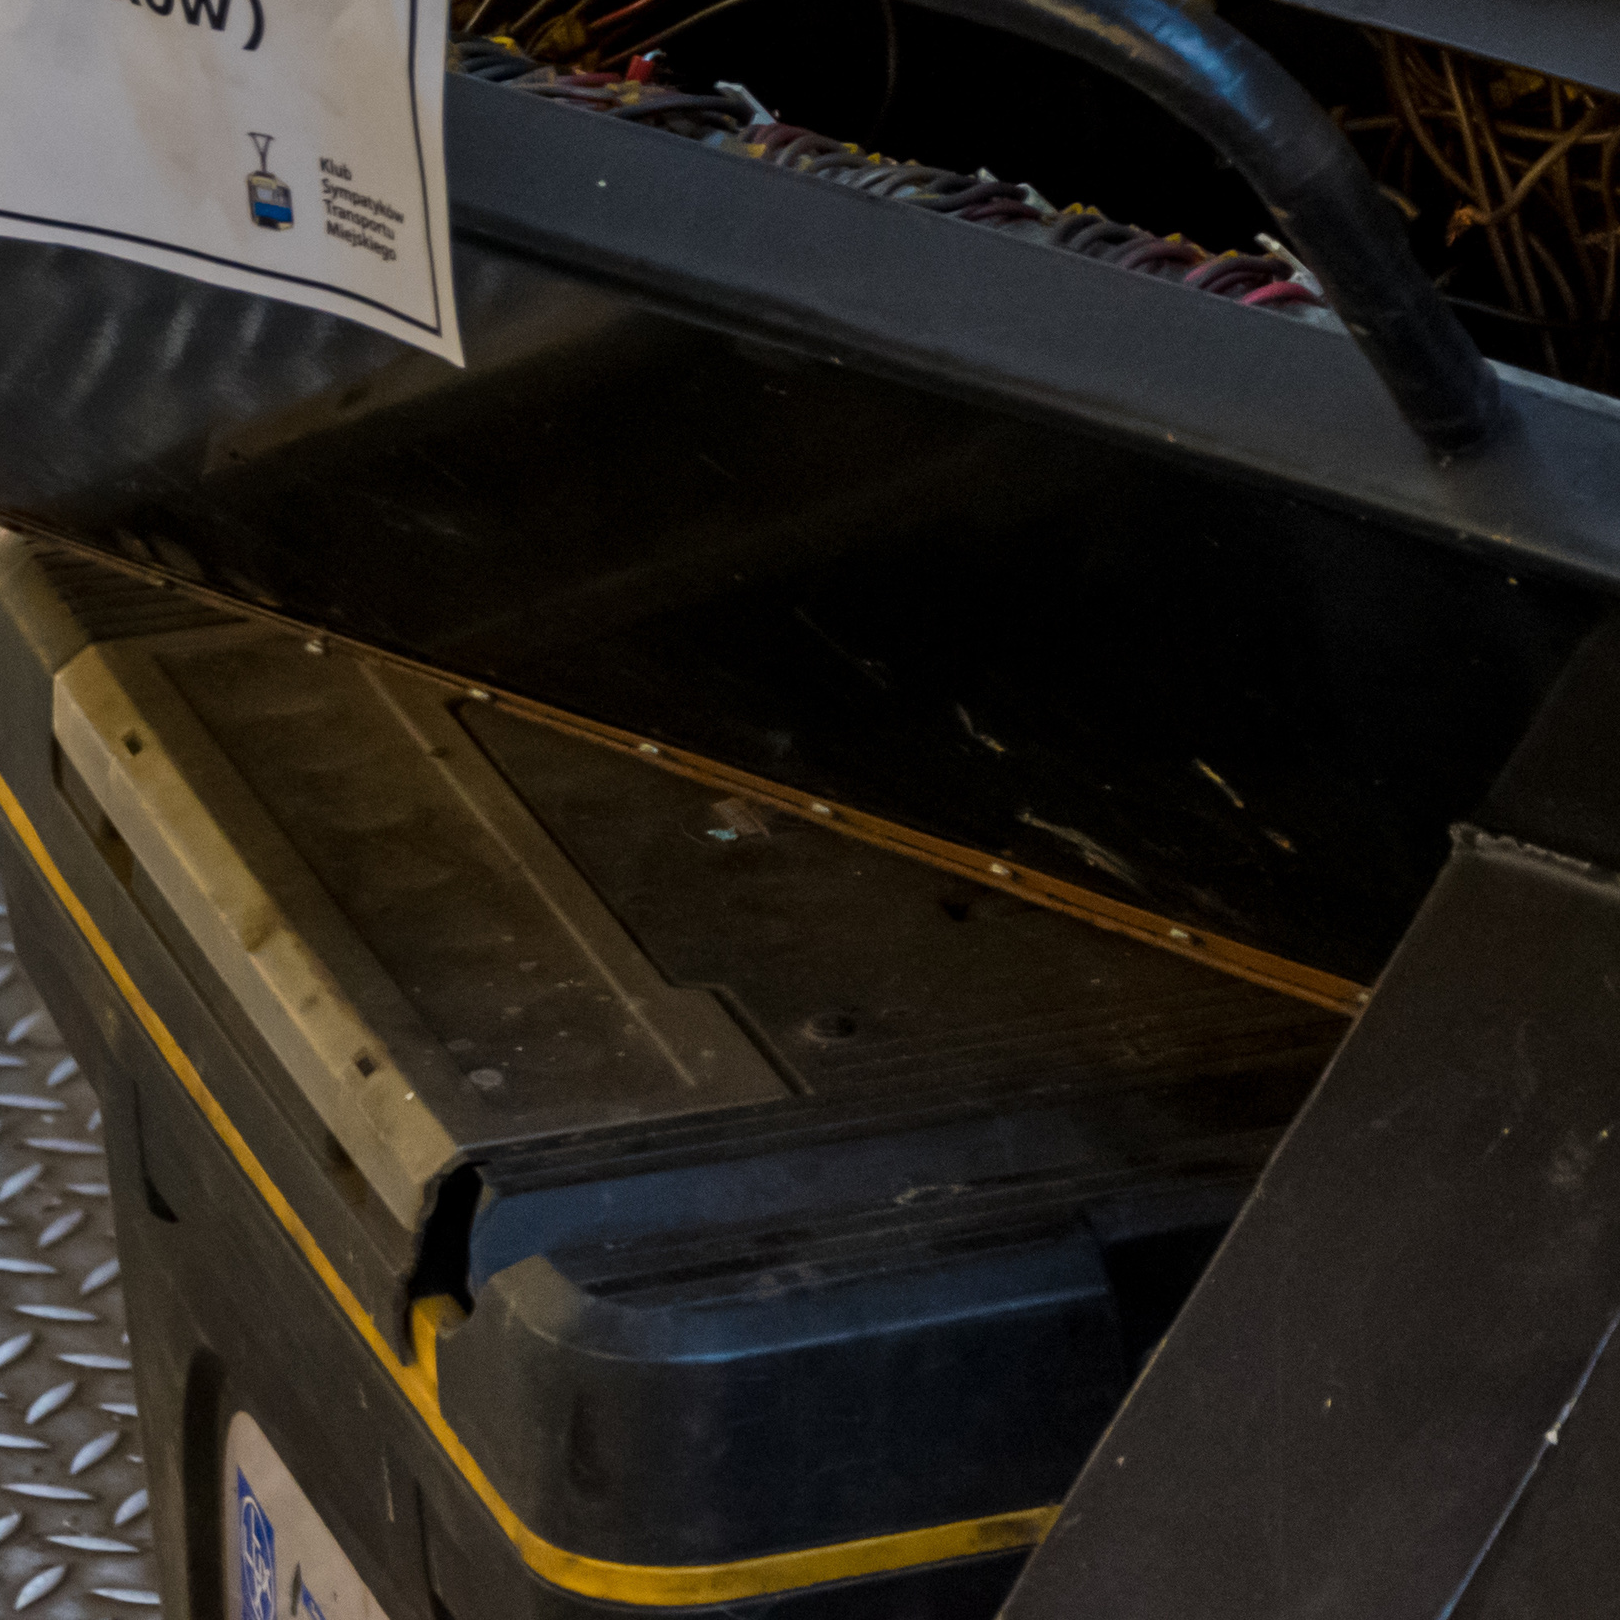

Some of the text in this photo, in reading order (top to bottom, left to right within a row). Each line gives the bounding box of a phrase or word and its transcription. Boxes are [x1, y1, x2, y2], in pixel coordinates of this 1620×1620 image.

[319, 157, 352, 181] Klub
[321, 177, 405, 224] Sympatyków
[323, 199, 396, 240] Transportu
[326, 220, 397, 261] Miejskiego
